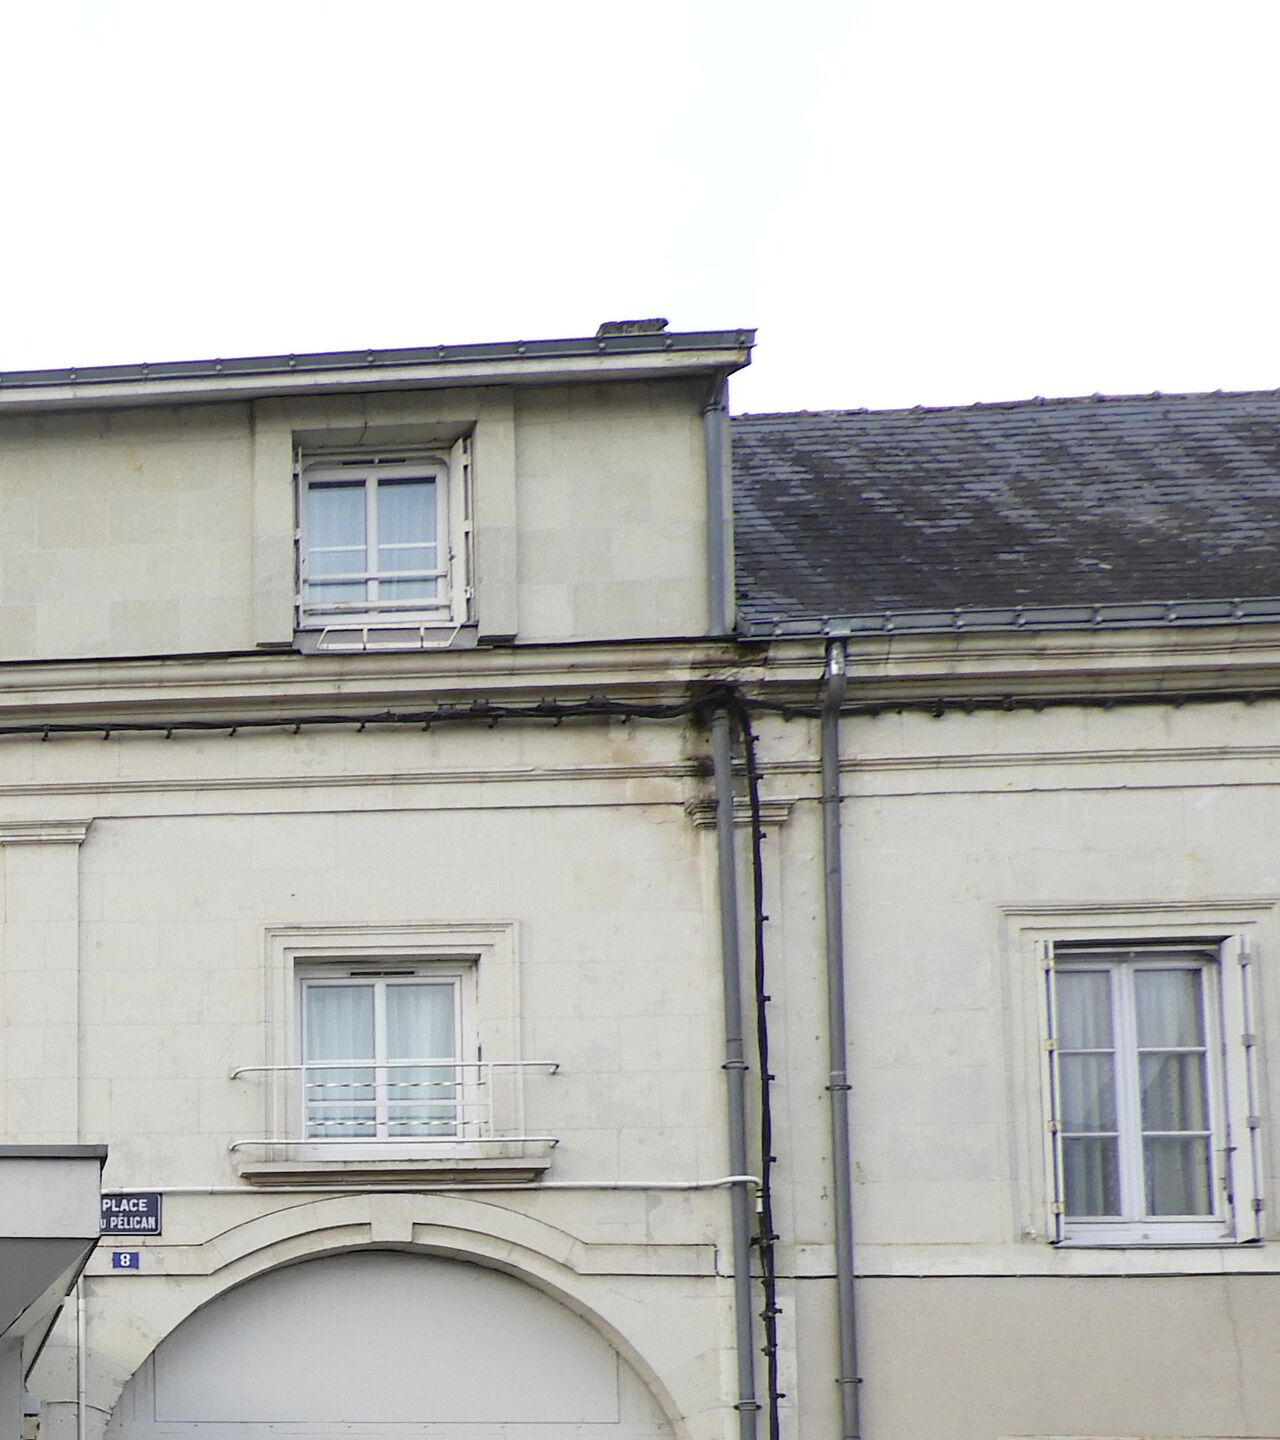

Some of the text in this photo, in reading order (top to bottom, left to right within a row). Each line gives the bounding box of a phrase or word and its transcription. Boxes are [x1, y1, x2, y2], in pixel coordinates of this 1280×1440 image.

[102, 1199, 148, 1212] PLACE
[110, 1214, 156, 1229] PÉLICAN
[119, 1253, 131, 1267] 8
